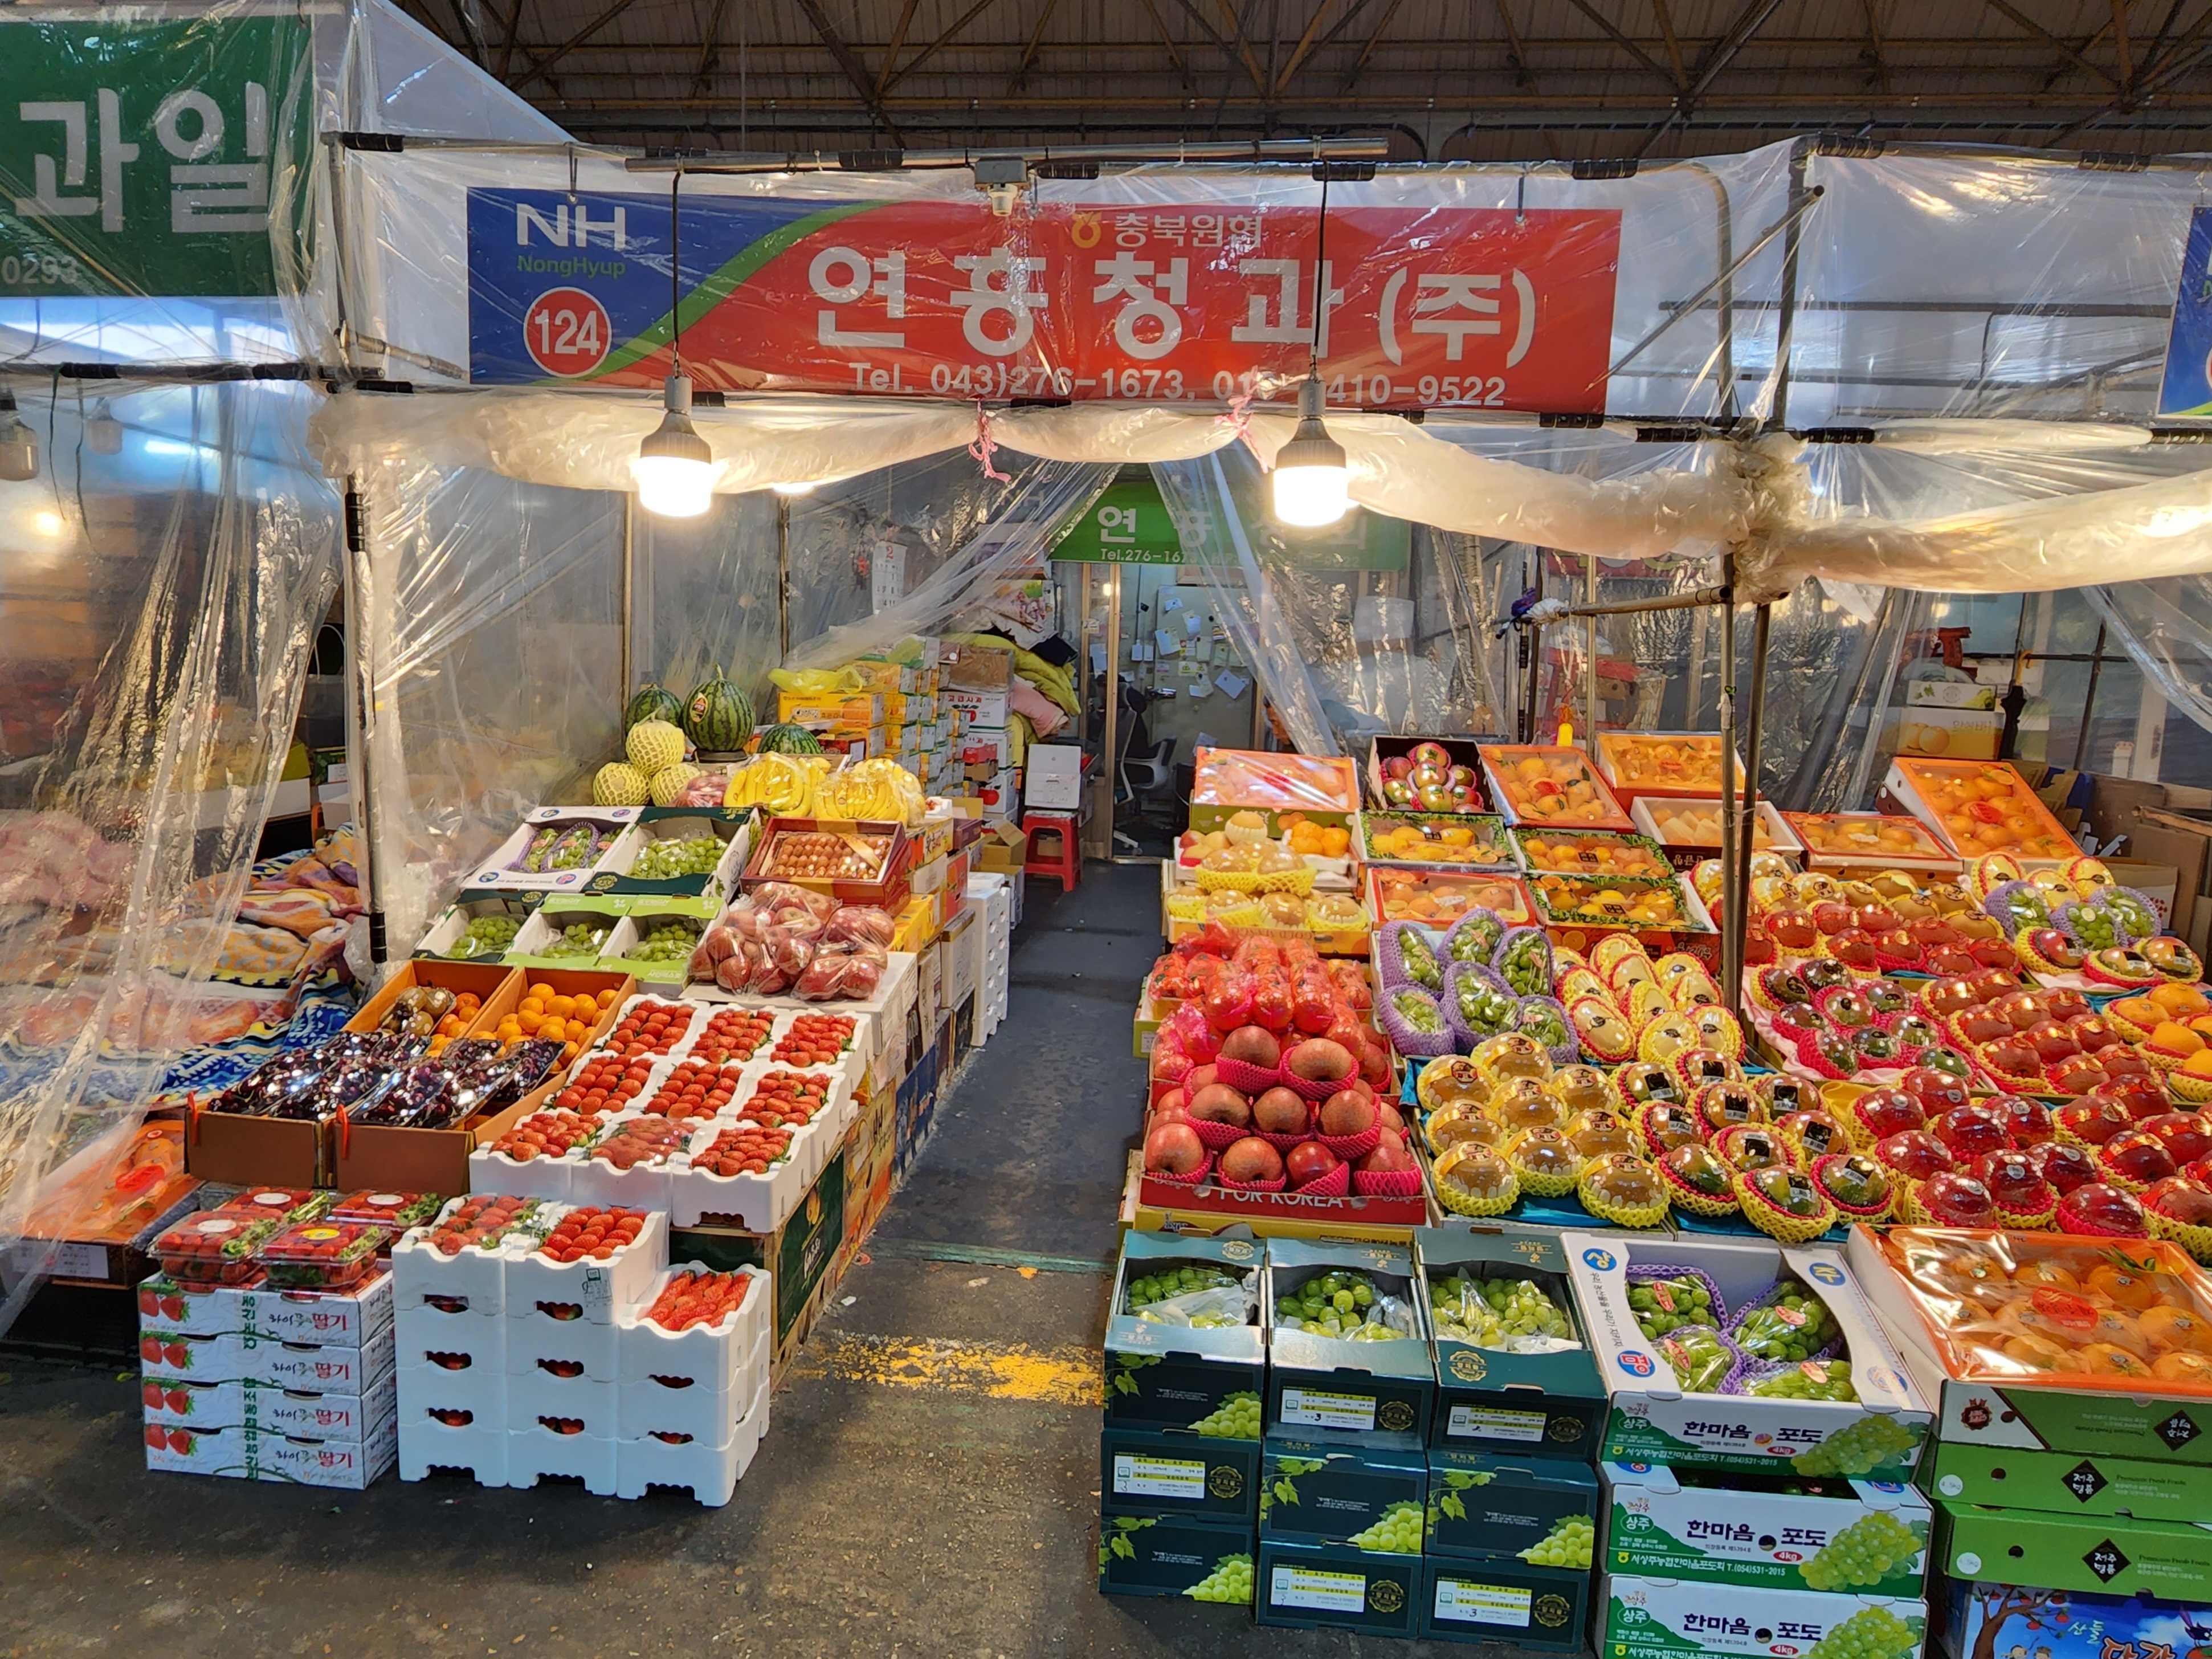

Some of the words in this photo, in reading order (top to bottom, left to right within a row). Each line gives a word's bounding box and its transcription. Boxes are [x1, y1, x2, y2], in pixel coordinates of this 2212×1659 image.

[14, 81, 268, 233] 과일
[516, 203, 626, 248] NH
[1113, 213, 1262, 248] 충북원협
[517, 255, 626, 279] NongHyup
[534, 309, 601, 356] 124
[849, 362, 913, 393] Tel.
[1623, 1416, 1647, 1430] 상주
[1683, 1421, 1753, 1440] 한마음
[1776, 1427, 1824, 1444] 포도
[1772, 1446, 1791, 1455] 4kg
[1626, 1517, 1650, 1530] 상주
[1687, 1520, 1756, 1542] 한마음
[1781, 1527, 1827, 1547] 포도
[1631, 1554, 1725, 1571] 서상주농협한마음포도회
[1727, 1563, 1786, 1576] T.(054)531-2015
[1778, 1551, 1797, 1562] 4kg
[1622, 1609, 1647, 1624] 상주
[1683, 1613, 1751, 1636] 한마음
[1777, 1622, 1822, 1641] 포도
[1774, 1645, 1793, 1656] 4kg
